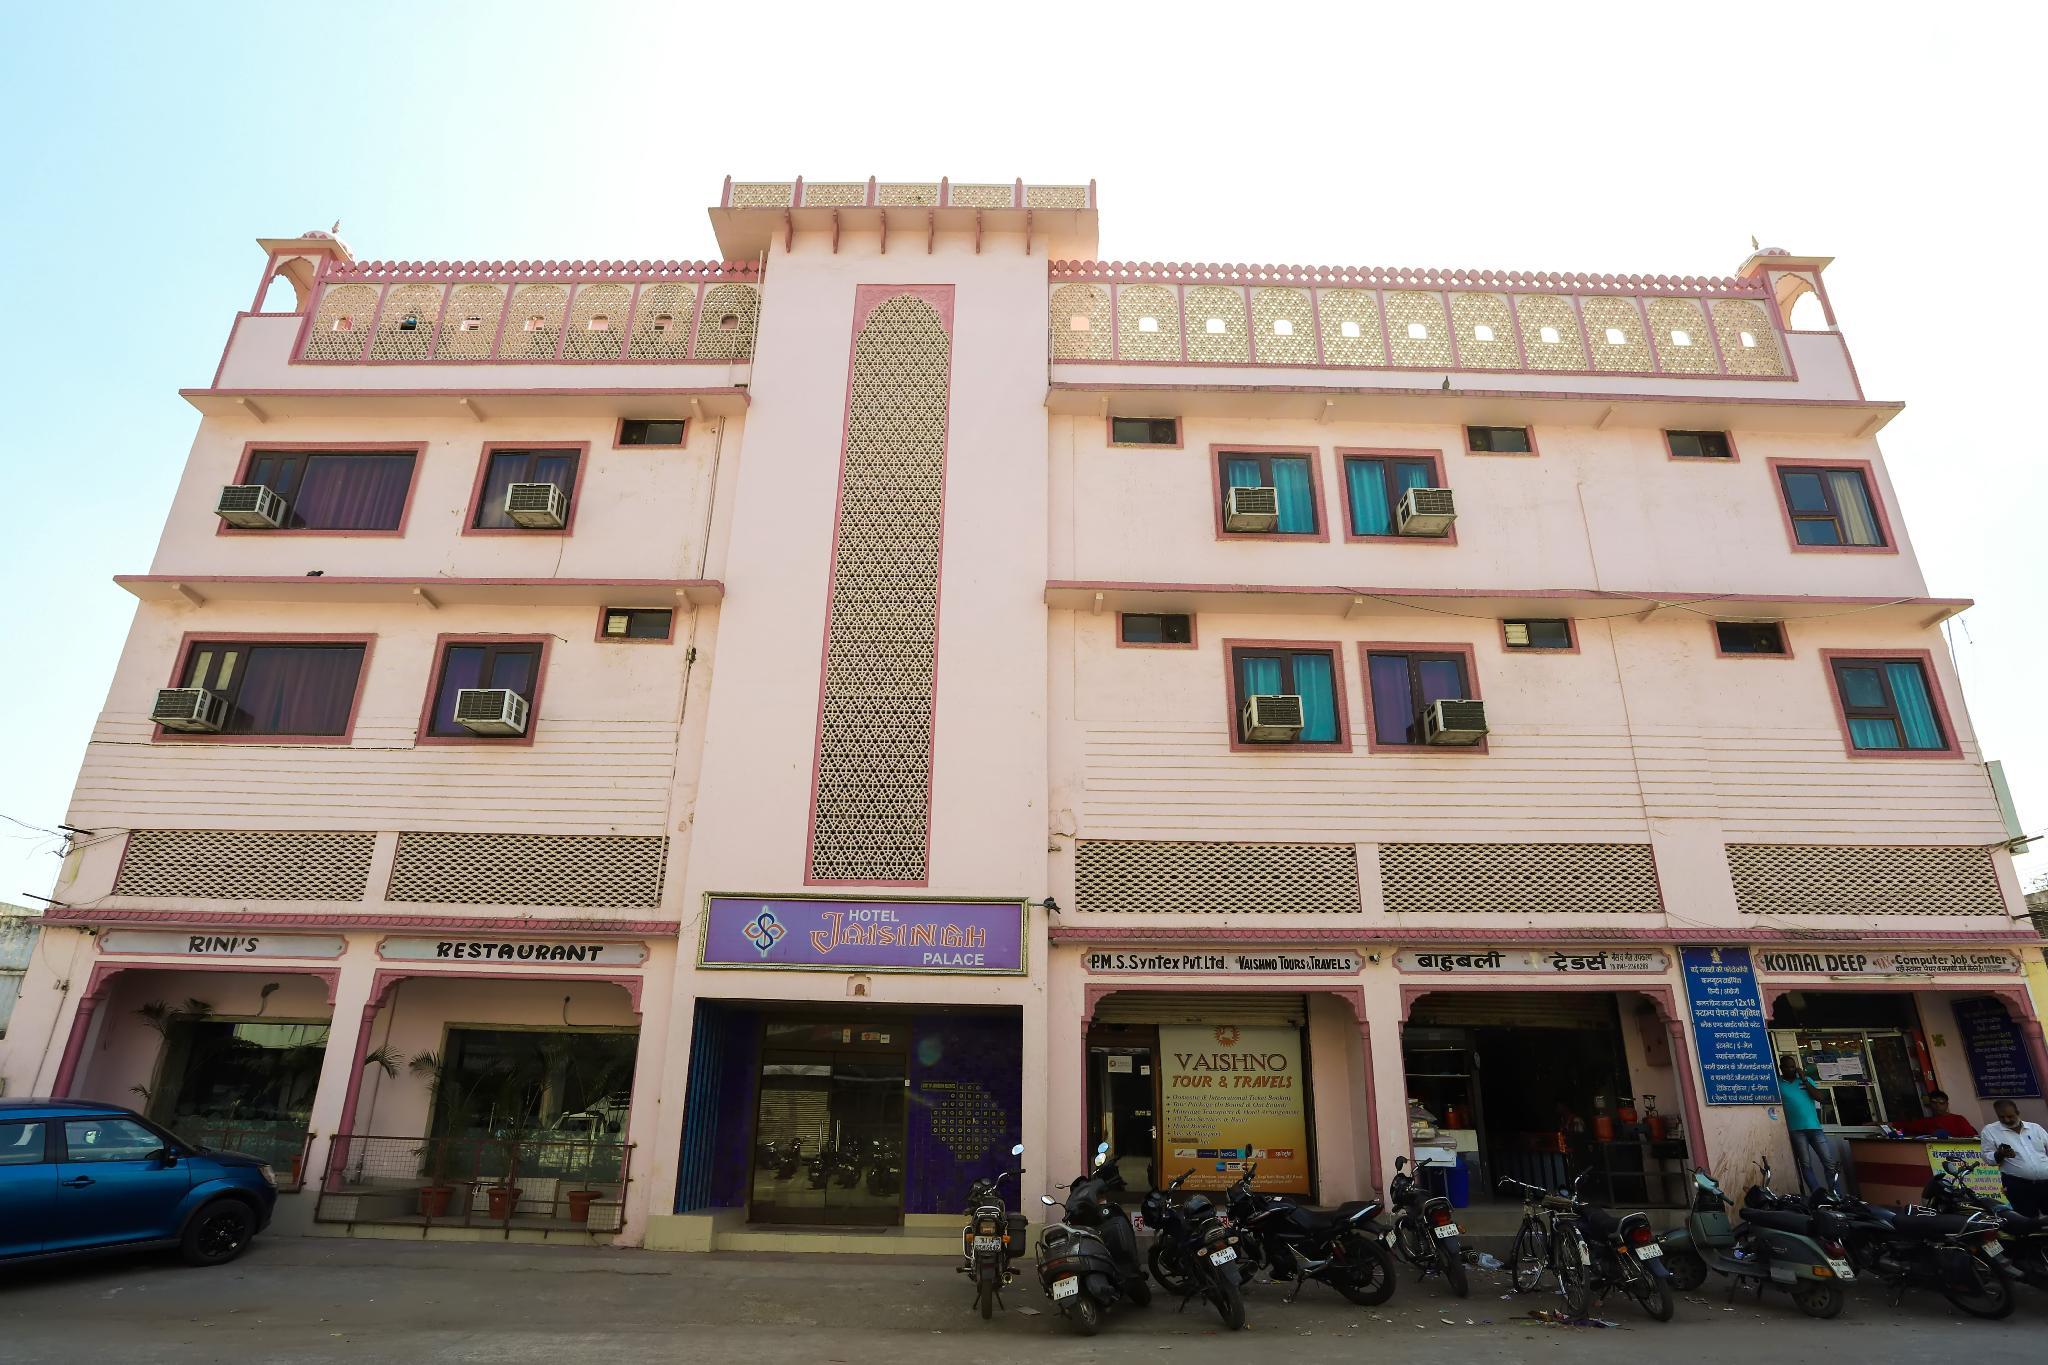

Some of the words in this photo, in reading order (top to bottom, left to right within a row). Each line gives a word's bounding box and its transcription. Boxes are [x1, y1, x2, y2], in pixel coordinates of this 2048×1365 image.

[849, 909, 900, 923] HOTEL
[810, 911, 986, 955] JAISINGH
[188, 935, 260, 953] RINI'S
[436, 941, 604, 961] RESTAURANT
[923, 952, 985, 966] PALACE
[1238, 956, 1277, 970] VAISHNO
[1415, 951, 1505, 972] बाहुबली
[1549, 951, 1608, 971] ट्रेडर्स
[1765, 953, 1825, 972] KOMAL
[1826, 954, 1867, 972] DEEP
[1894, 954, 1949, 968] Computer
[1951, 954, 1968, 964] Job
[1969, 954, 2008, 964] Center
[1174, 1053, 1287, 1072] VAISHNO
[1172, 1075, 1213, 1088] TOUR
[1218, 1075, 1228, 1088] &
[1233, 1075, 1293, 1088] TRAVELS
